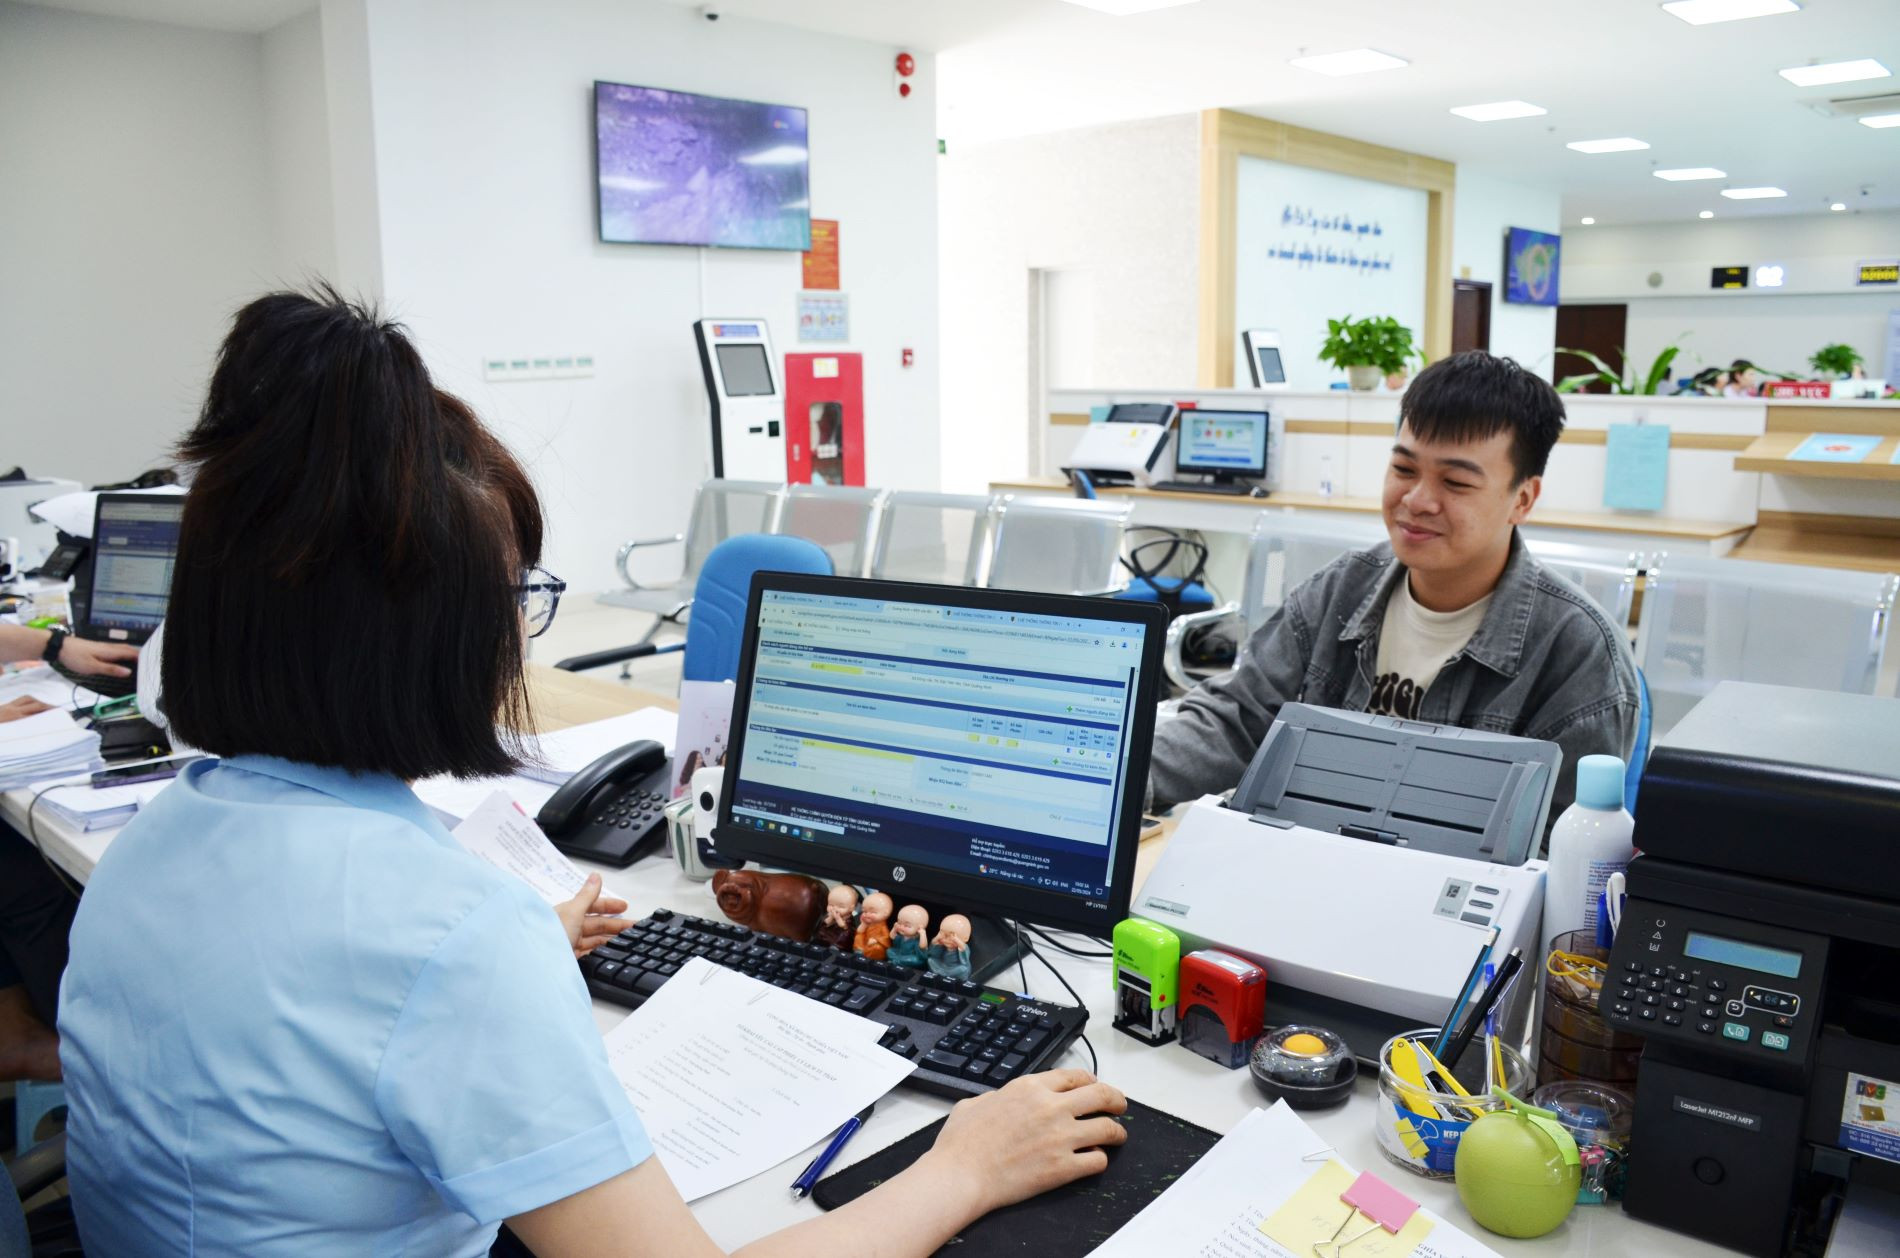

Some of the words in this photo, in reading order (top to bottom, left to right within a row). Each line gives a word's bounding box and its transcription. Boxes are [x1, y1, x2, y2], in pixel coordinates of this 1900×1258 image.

[893, 866, 906, 882] hp
[1017, 1004, 1048, 1017] Fühlen
[1680, 1101, 1707, 1114] LaserJet
[1737, 1116, 1754, 1125] MFP
